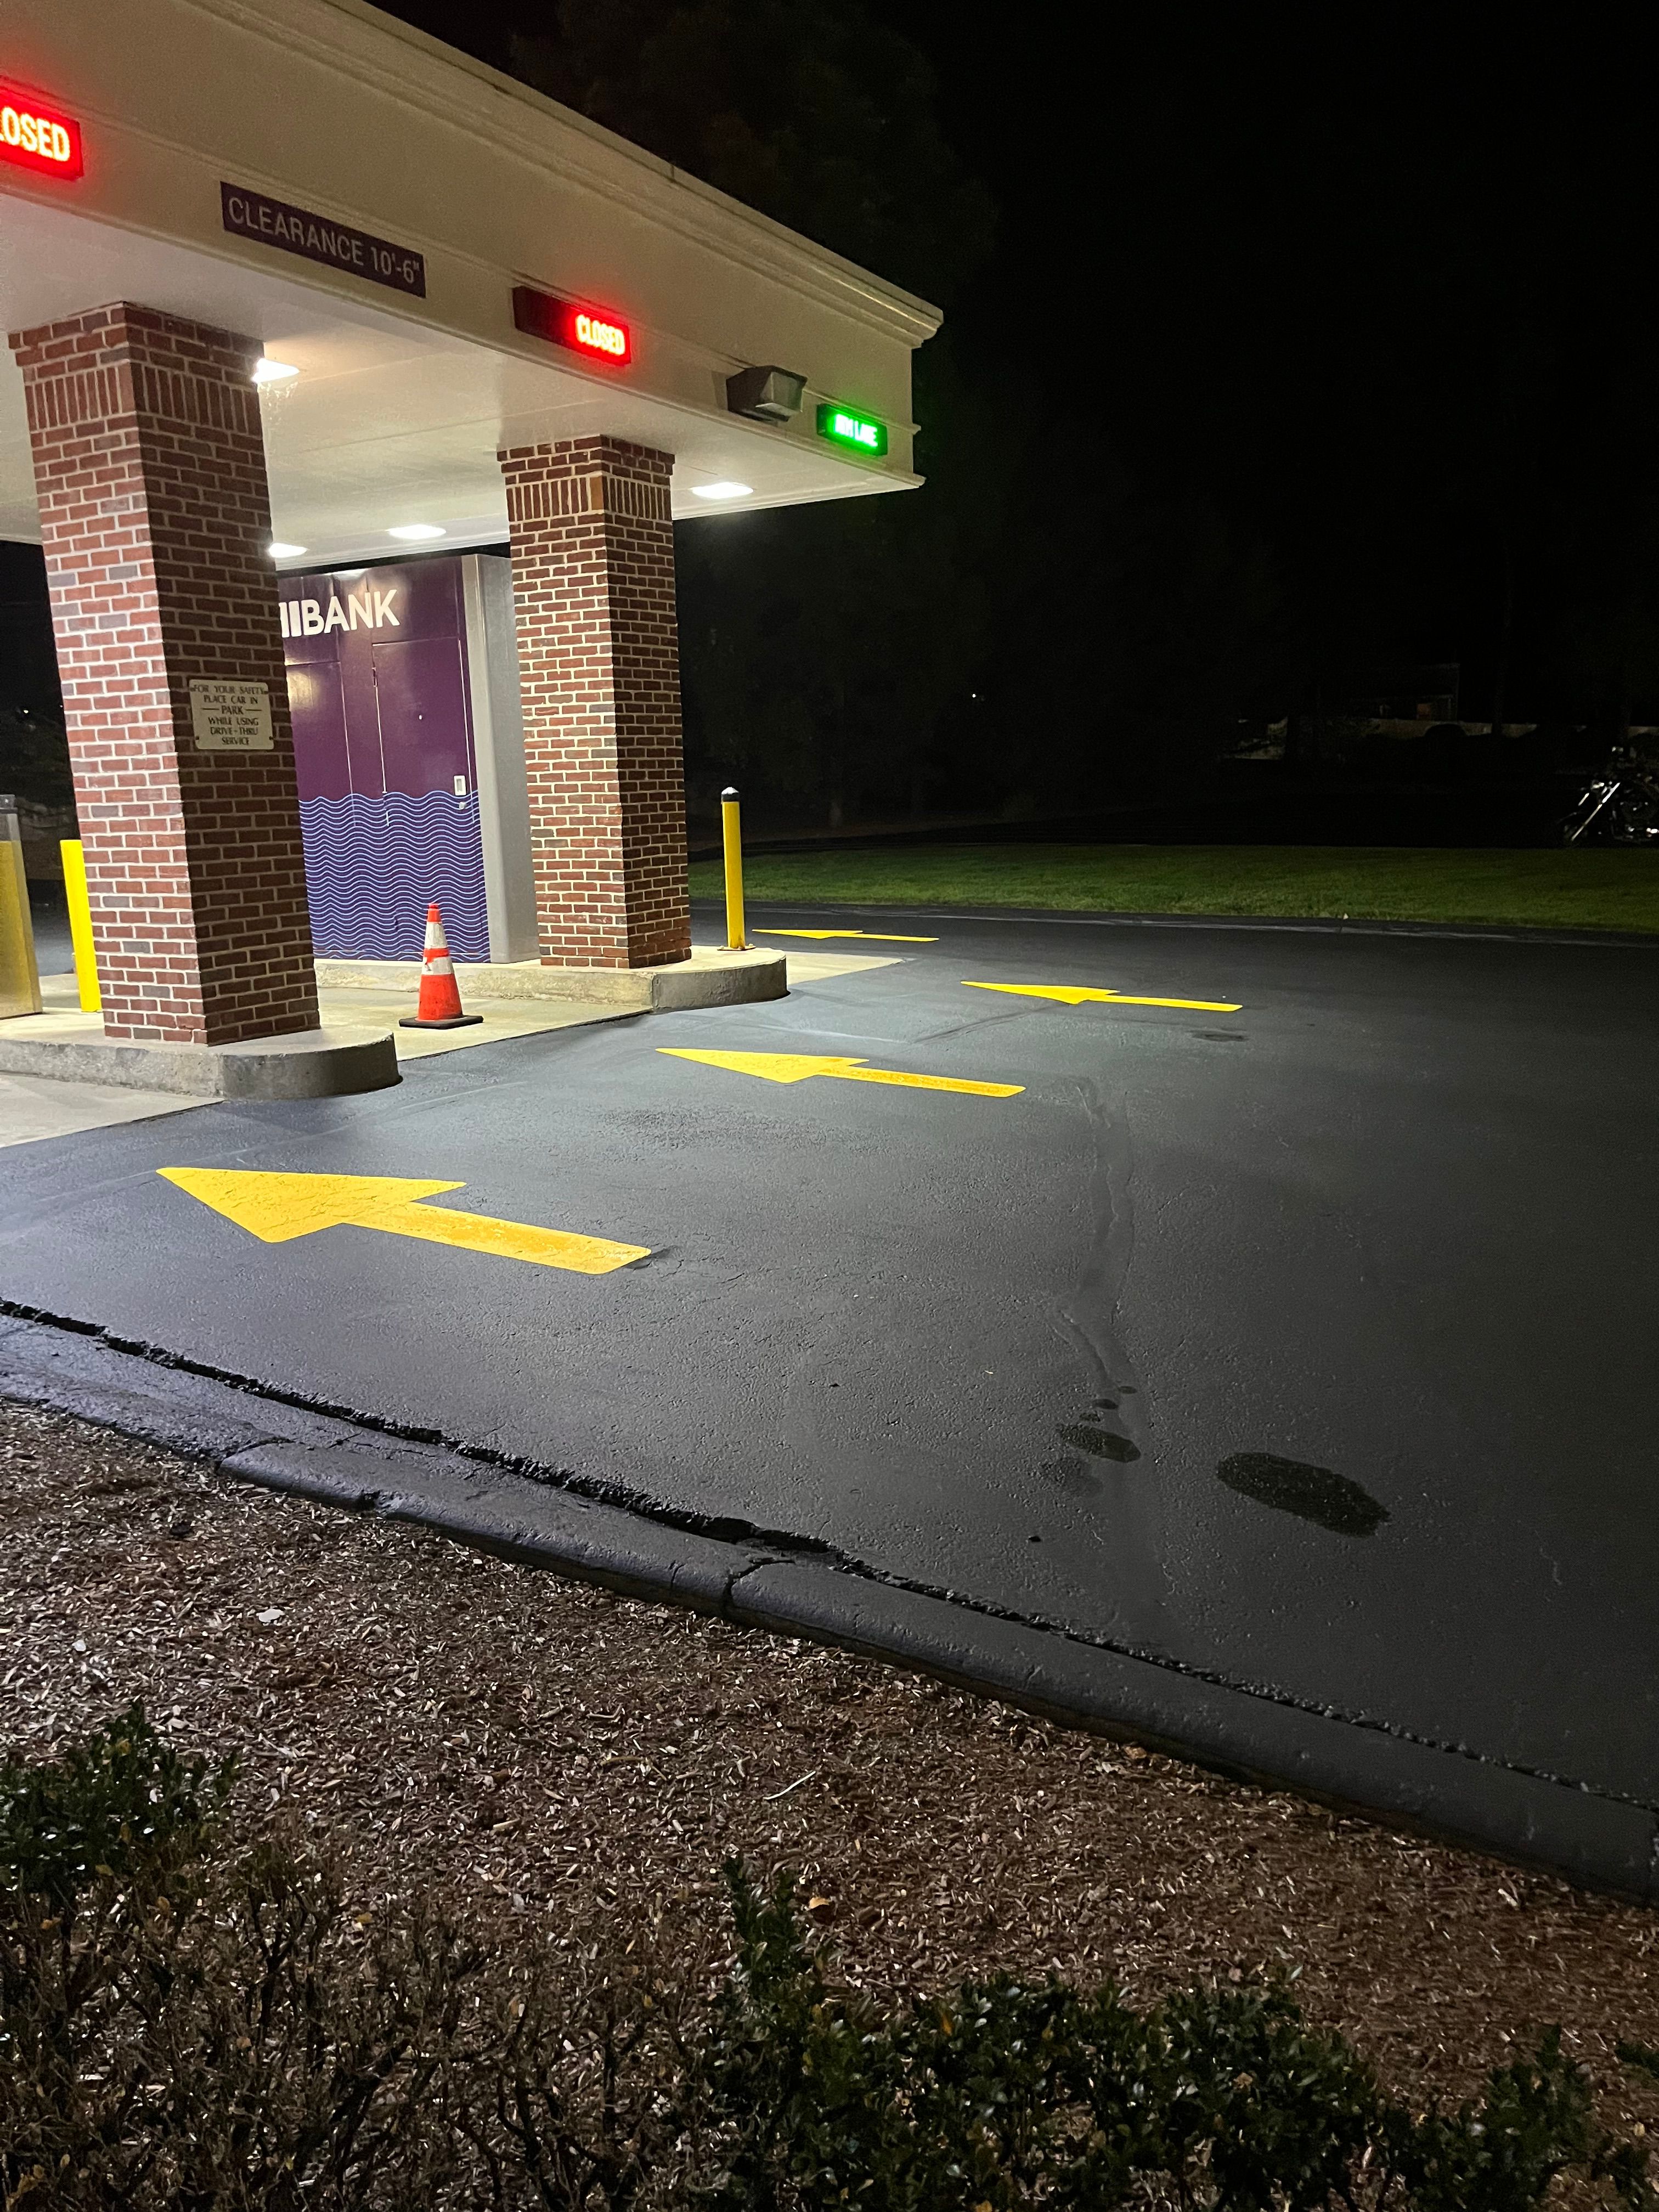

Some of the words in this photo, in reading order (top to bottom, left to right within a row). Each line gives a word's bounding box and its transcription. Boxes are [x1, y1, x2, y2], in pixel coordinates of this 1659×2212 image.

[0, 106, 70, 161] OSED
[228, 197, 364, 266] CLEARANCE
[576, 314, 625, 355] CLOSED
[215, 686, 235, 694] YOUR
[204, 695, 227, 703] PLACE
[231, 696, 246, 704] CAR
[221, 706, 244, 715] PARK
[208, 716, 232, 725] WHILE
[236, 717, 259, 726] USING
[222, 737, 250, 746] SERVICE
